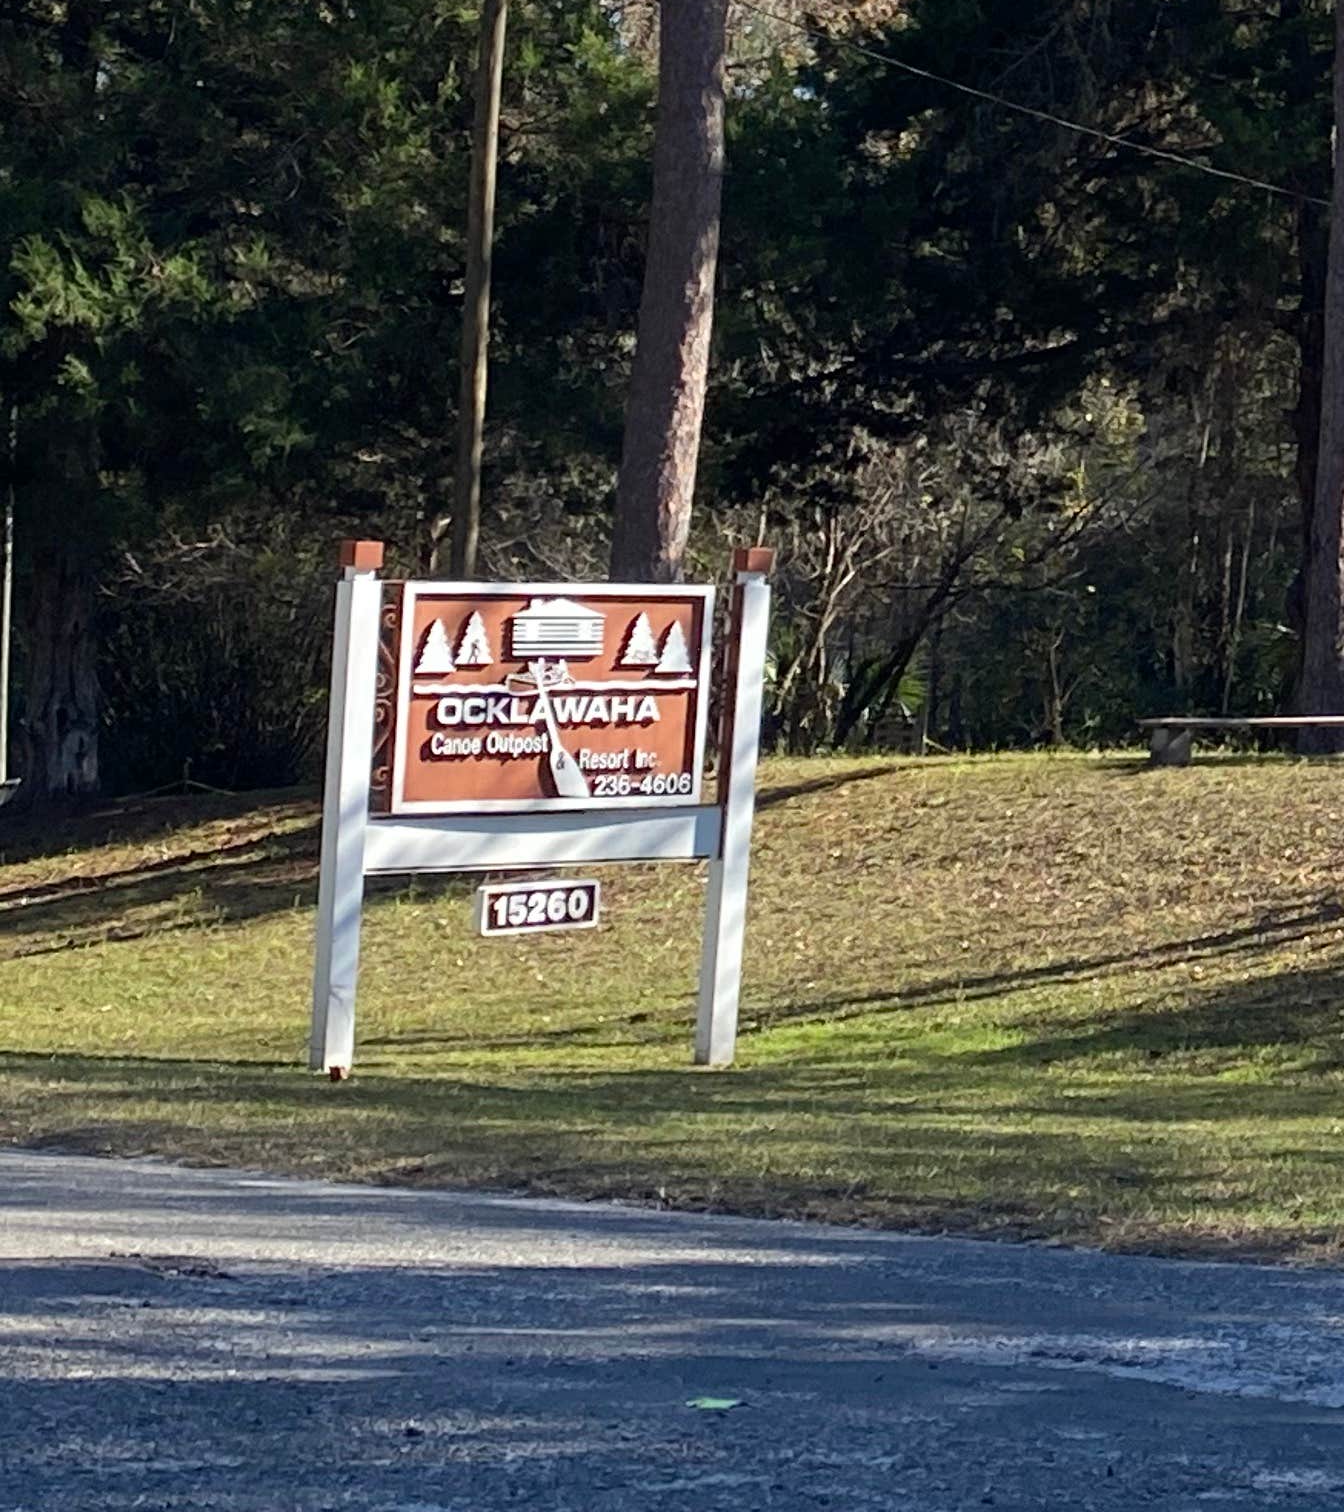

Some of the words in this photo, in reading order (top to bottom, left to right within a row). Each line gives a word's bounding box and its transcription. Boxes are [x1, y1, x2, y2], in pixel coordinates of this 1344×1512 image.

[437, 696, 661, 724] OCKLAWAHA
[431, 732, 481, 755] Canoe
[486, 731, 548, 758] Outpost
[556, 750, 565, 770] &
[579, 748, 628, 770] Resort
[593, 772, 692, 796] 236-4606
[493, 889, 589, 926] 15260
